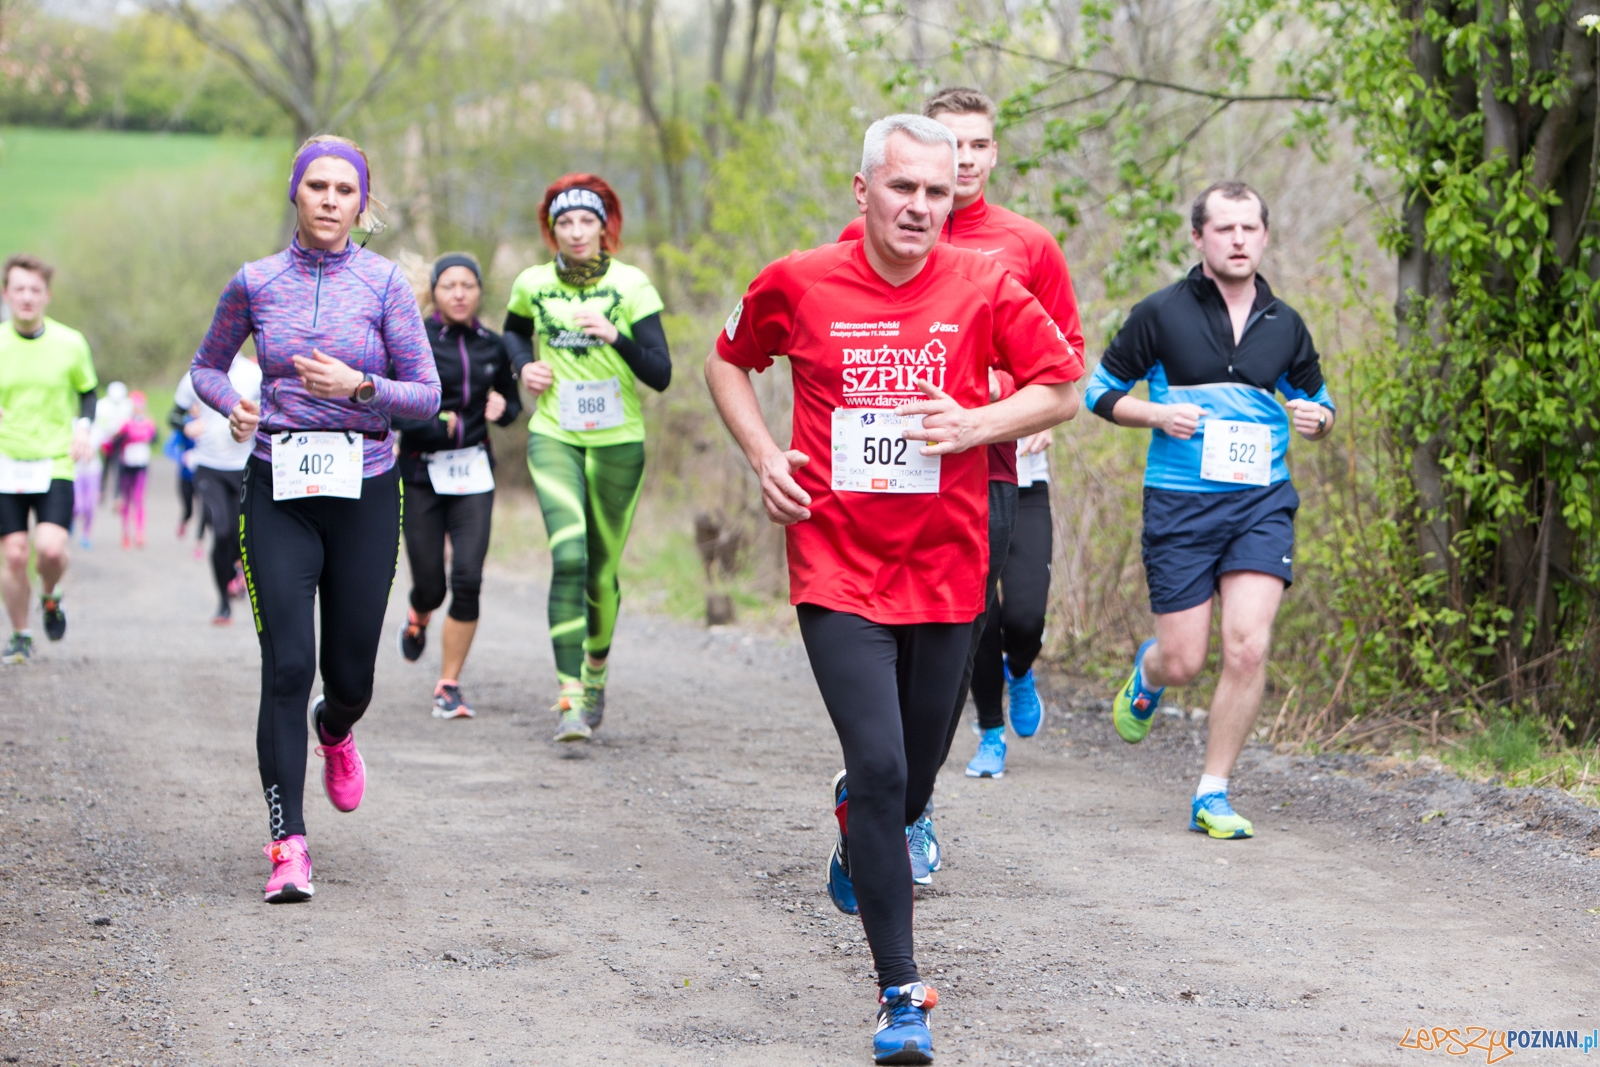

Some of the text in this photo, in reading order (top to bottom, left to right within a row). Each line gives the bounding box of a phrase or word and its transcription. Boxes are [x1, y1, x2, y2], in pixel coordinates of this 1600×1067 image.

[834, 321, 877, 330] Mistrzostwa
[878, 321, 900, 330] Polski
[842, 344, 930, 365] DRUŻYNA
[842, 365, 947, 393] SZPIKU
[578, 396, 605, 414] 868
[863, 437, 908, 465] 502
[1229, 442, 1256, 464] 522
[299, 454, 334, 475] 402
[901, 469, 922, 477] 10KM
